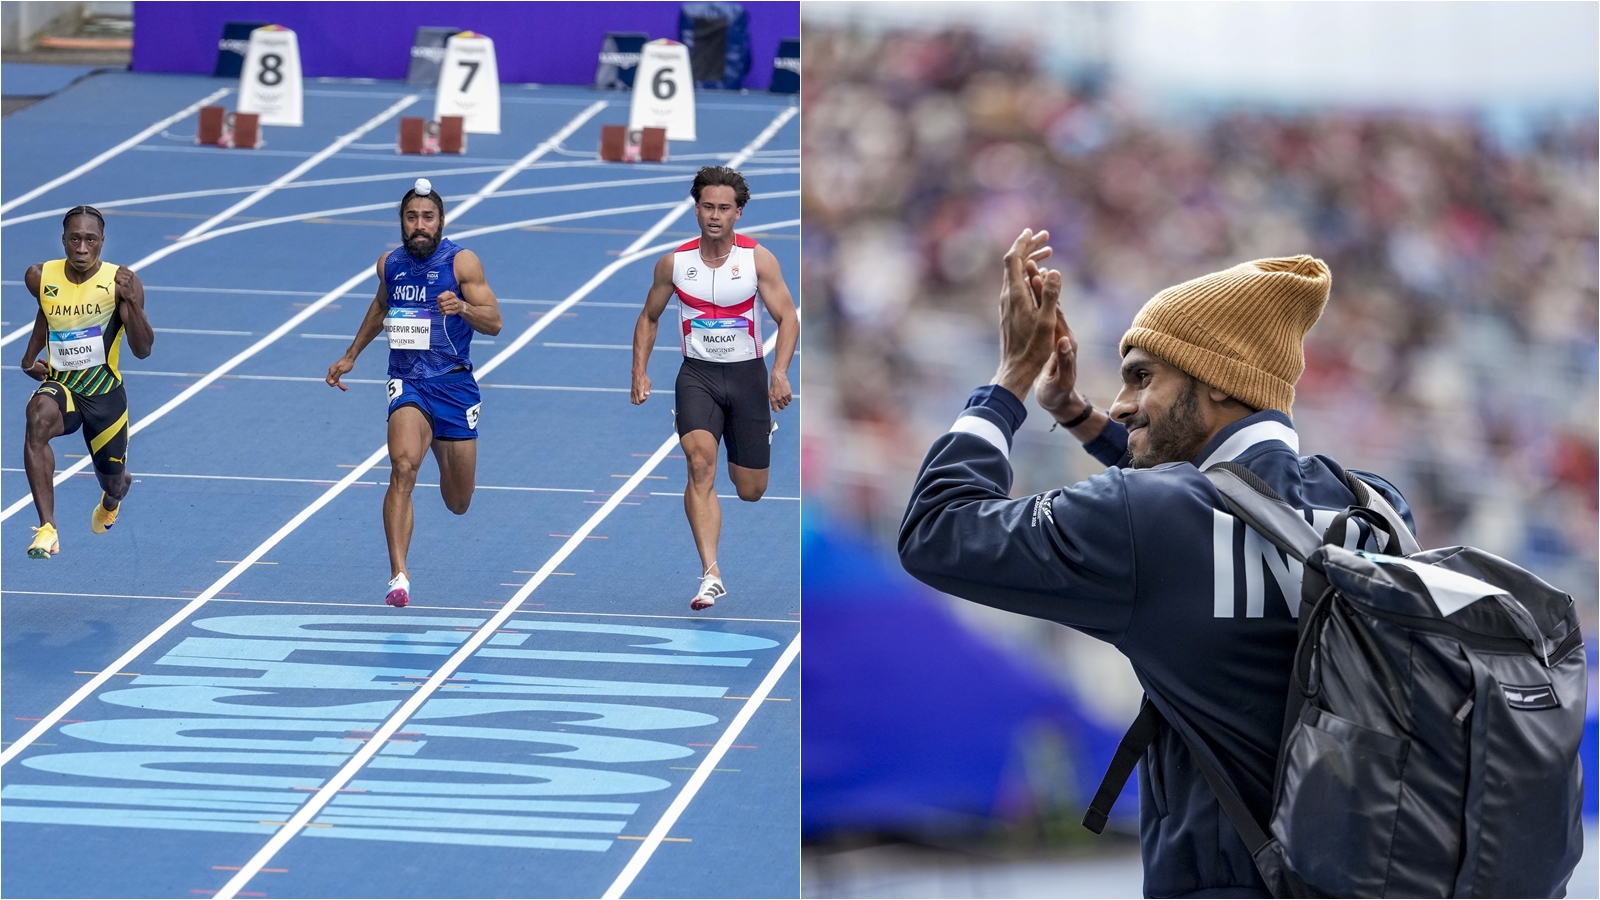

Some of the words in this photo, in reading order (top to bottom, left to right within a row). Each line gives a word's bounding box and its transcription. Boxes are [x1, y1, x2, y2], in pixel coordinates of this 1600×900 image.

[258, 54, 283, 86] 8
[457, 61, 481, 93] 7
[652, 67, 677, 100] 6
[393, 285, 426, 302] INDIA
[48, 303, 101, 316] JAMAICA
[411, 326, 429, 334] SINGH
[703, 334, 736, 343] MACKAY
[58, 345, 92, 356] WATSON
[62, 358, 91, 367] LONGINES
[388, 382, 397, 397] 5
[472, 408, 479, 423] 5
[2, 614, 780, 852] GLASGOW
